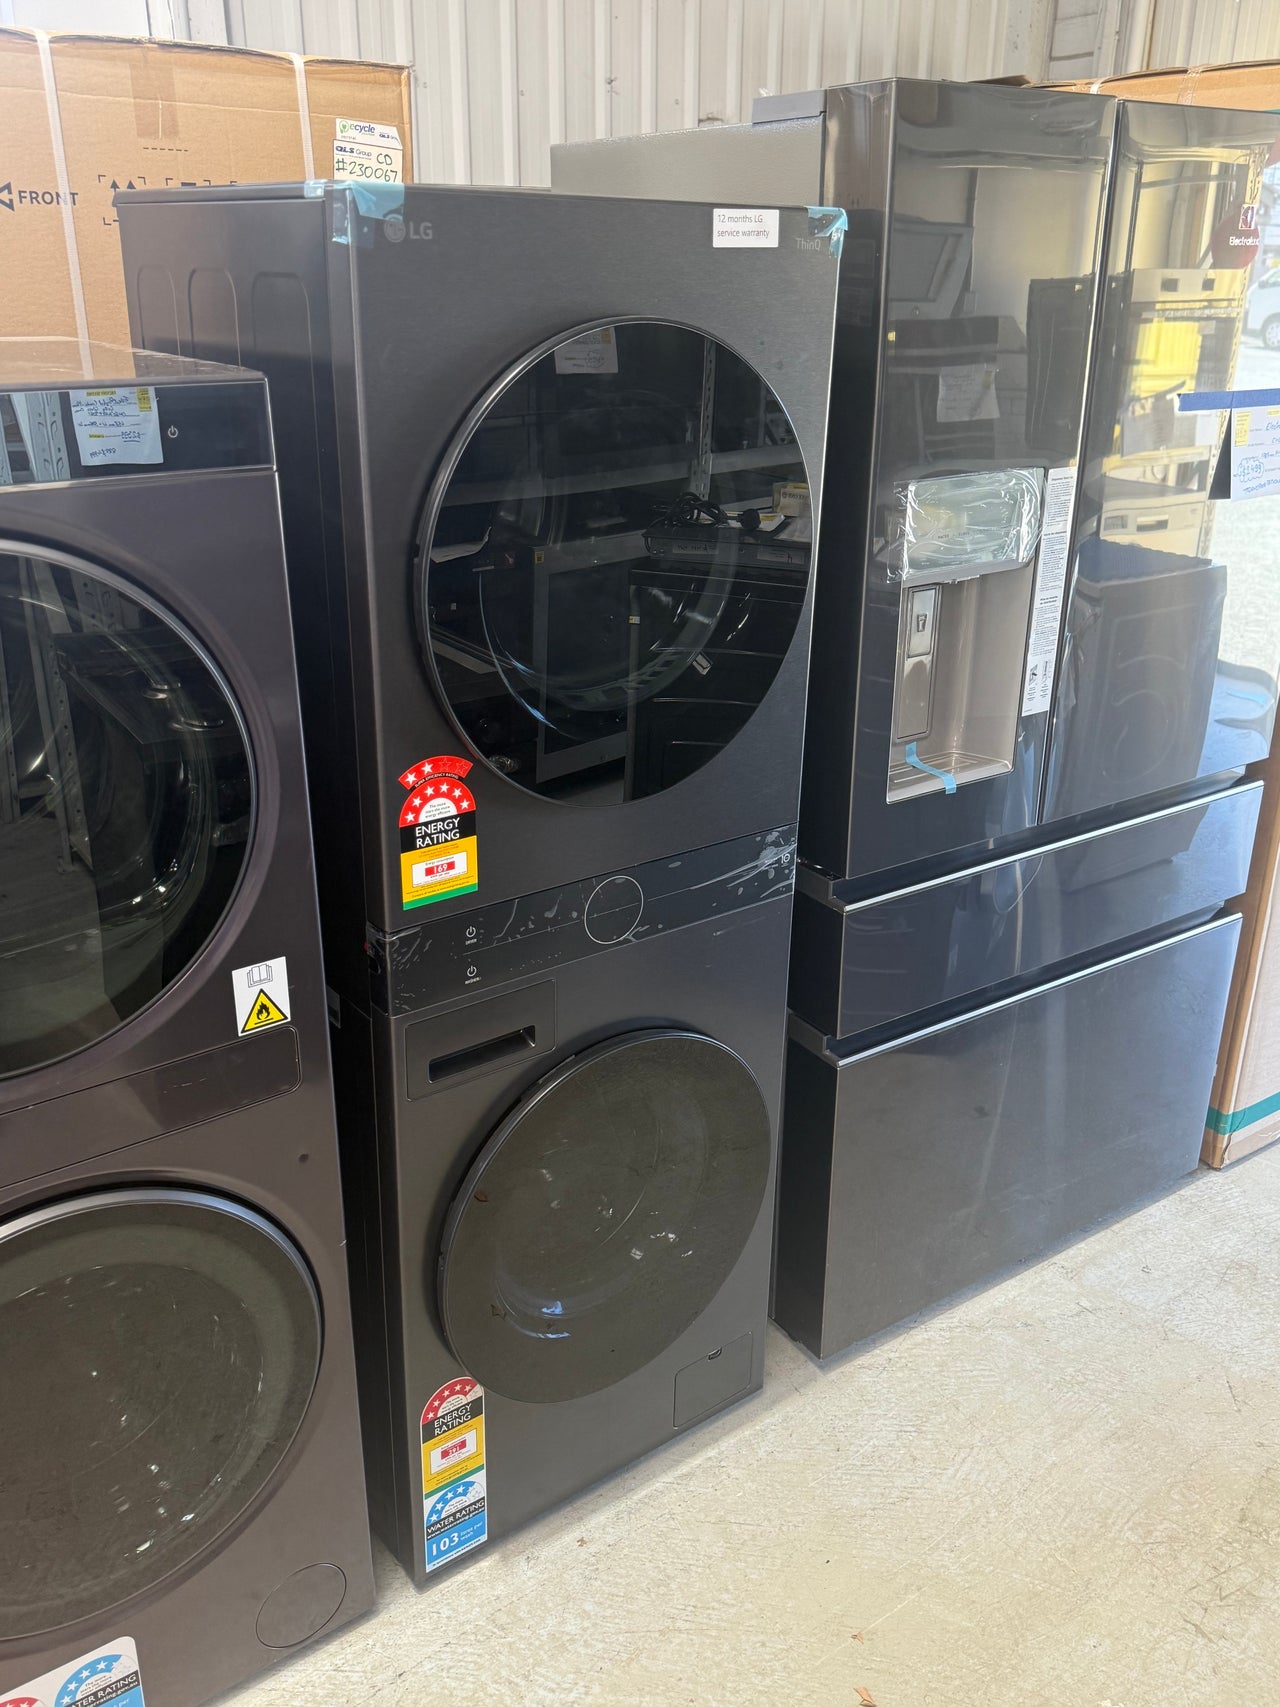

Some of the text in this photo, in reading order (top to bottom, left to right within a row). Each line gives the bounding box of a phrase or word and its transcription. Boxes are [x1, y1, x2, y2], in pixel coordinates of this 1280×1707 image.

[335, 157, 398, 183] #230067
[718, 214, 763, 224] 12 months LG
[409, 221, 433, 240] LG
[717, 229, 770, 239] service warranty
[796, 238, 821, 250] ThinQ
[415, 817, 460, 837] ENERGY
[416, 829, 460, 849] RATING
[434, 863, 448, 875] 169
[434, 1403, 472, 1428] ENERGY
[434, 1412, 471, 1436] RATING
[427, 1515, 454, 1534] WATER
[455, 1499, 485, 1519] RATING
[432, 1532, 459, 1556] 103
[97, 1673, 137, 1699] RATING
